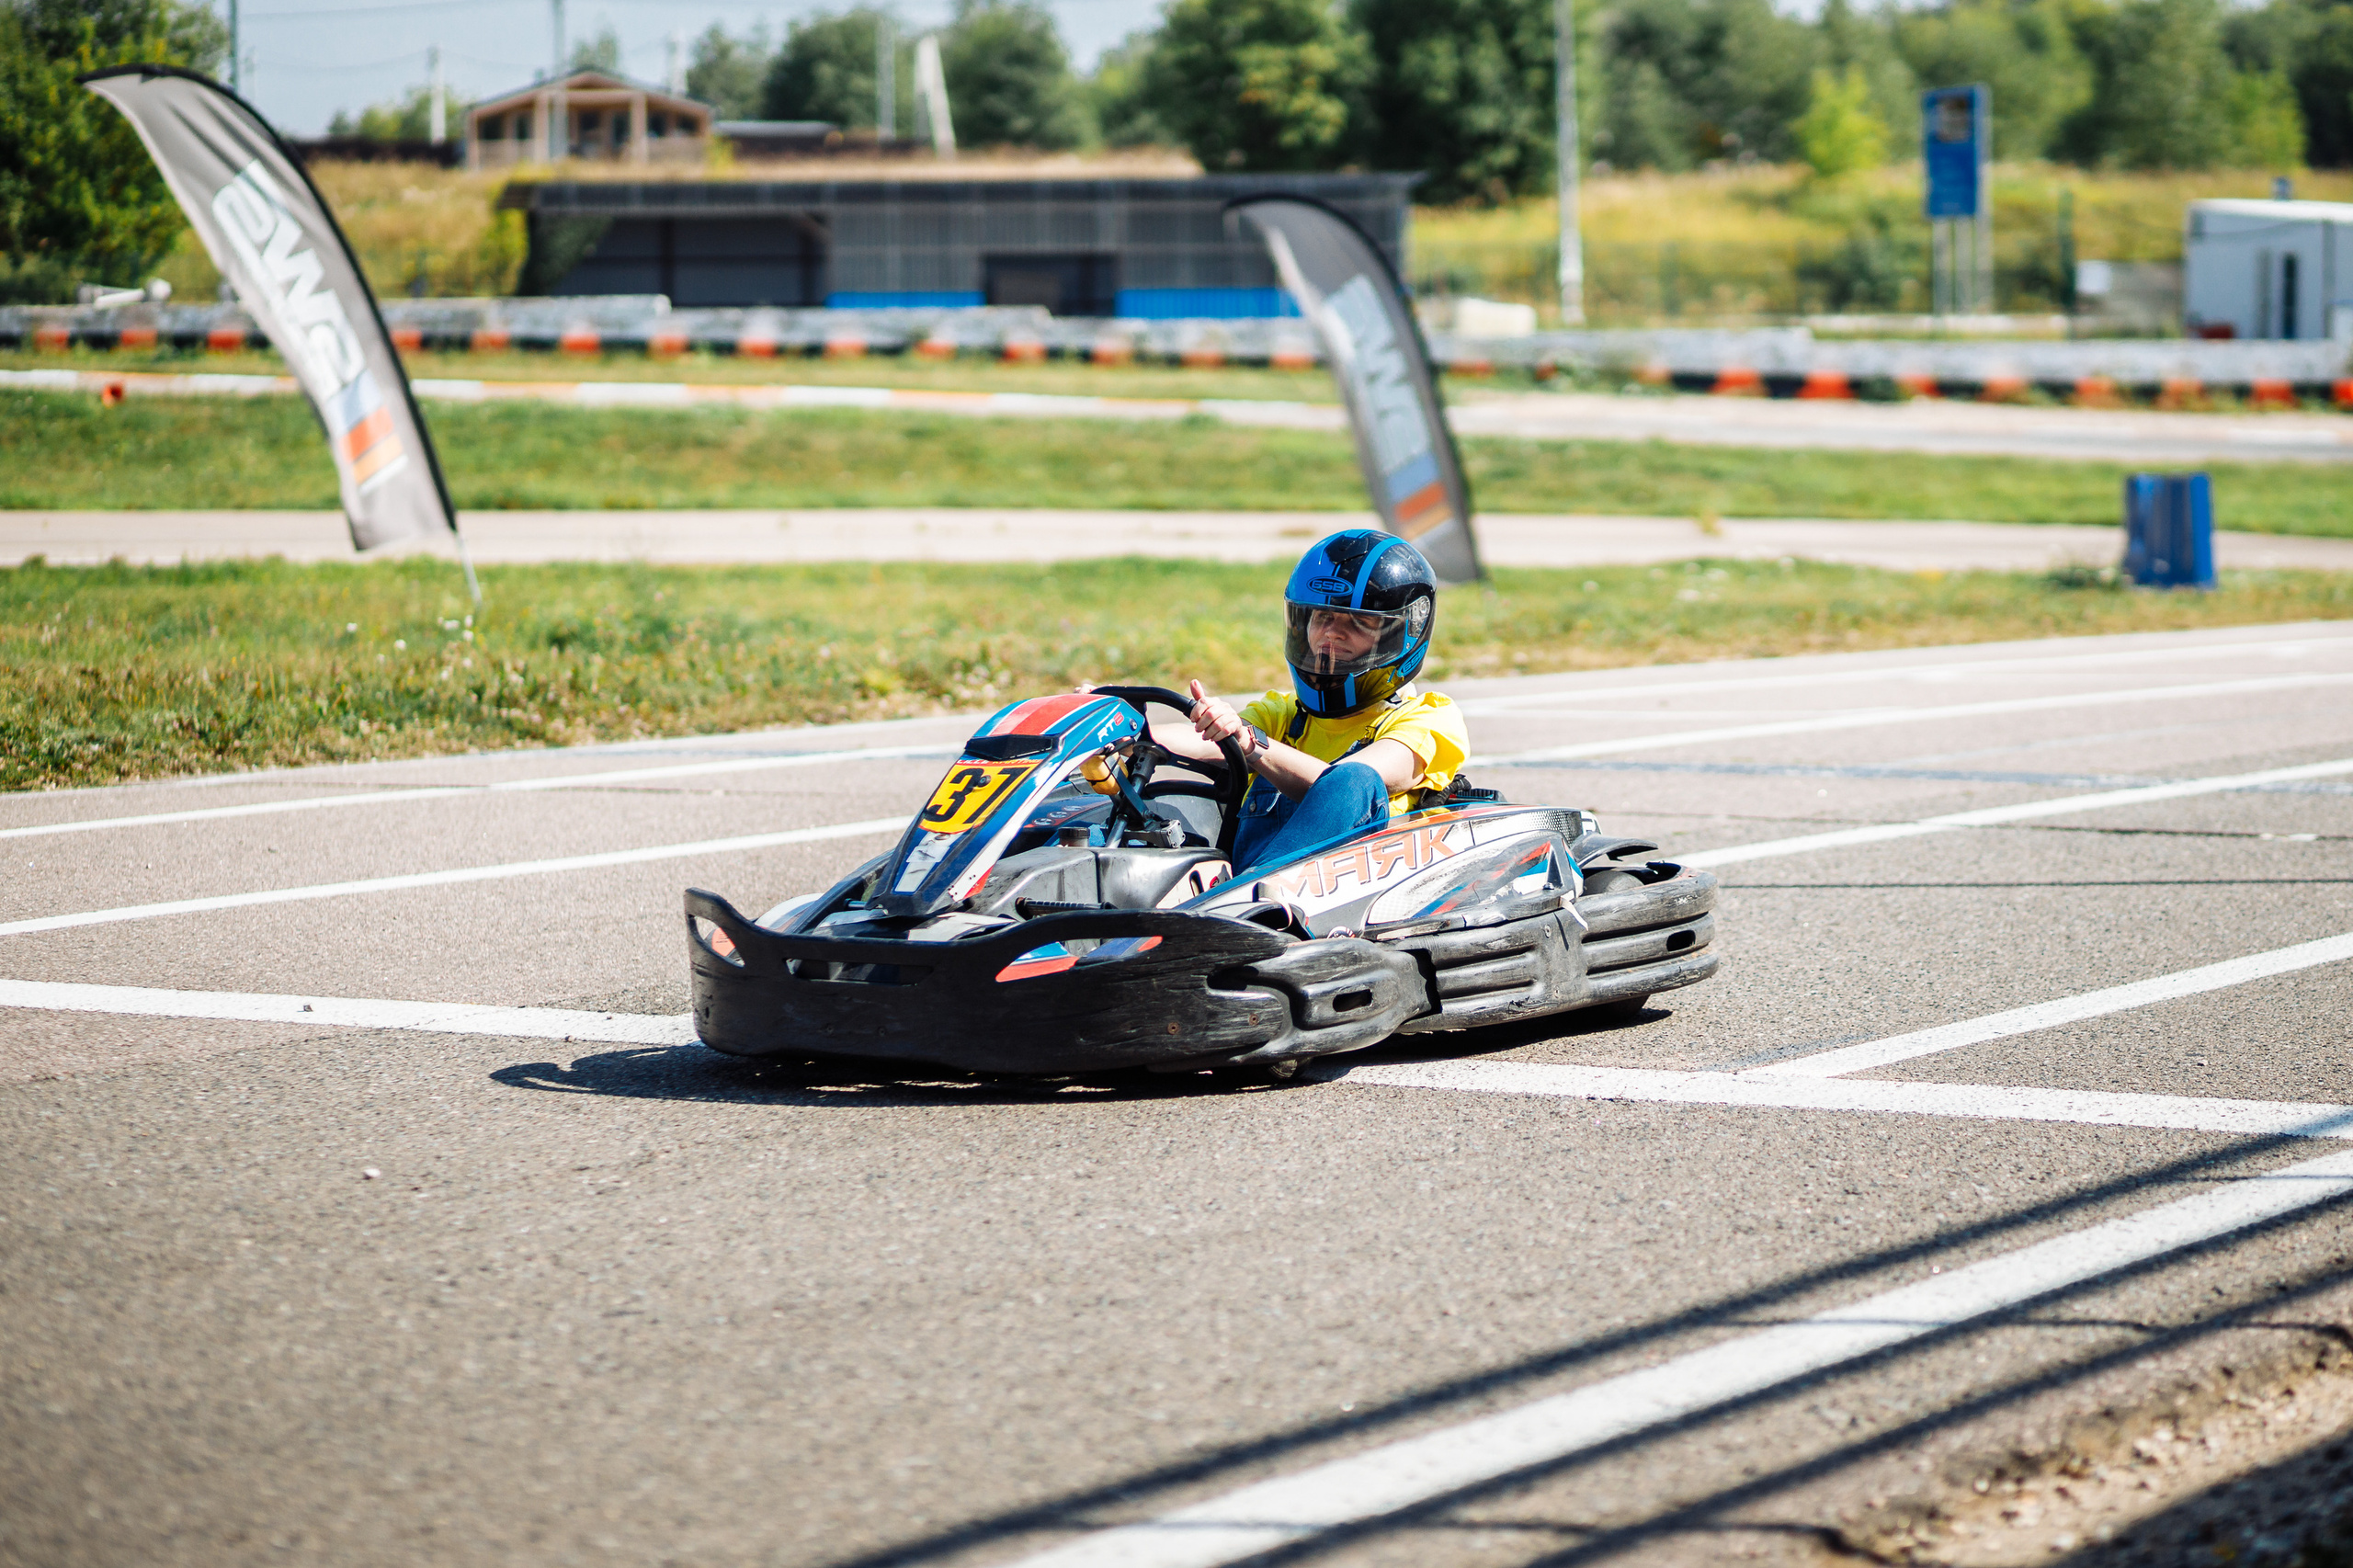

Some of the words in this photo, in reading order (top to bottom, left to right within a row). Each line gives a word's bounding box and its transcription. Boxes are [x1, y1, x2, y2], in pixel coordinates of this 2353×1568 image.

[1311, 580, 1346, 593] GSB
[1097, 711, 1124, 743] RT8
[923, 767, 1030, 824] 37
[1267, 823, 1457, 897] МАЯК
